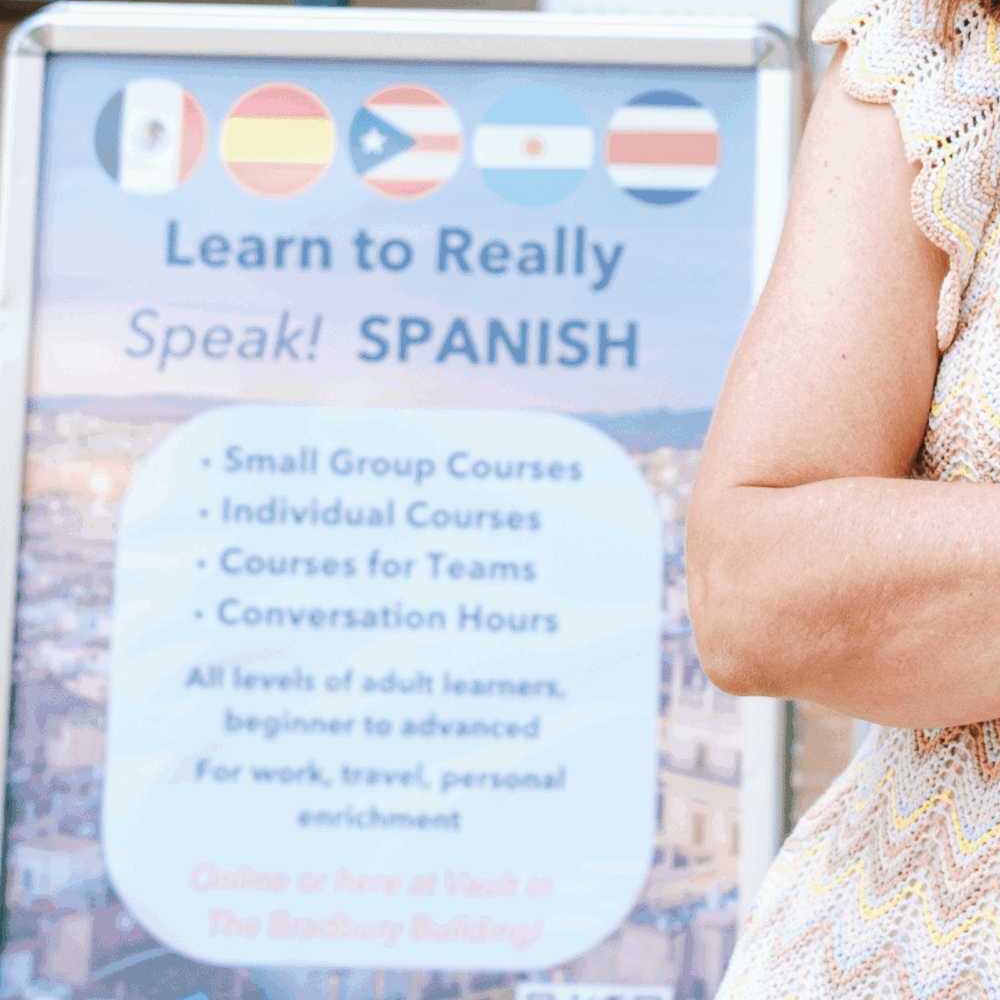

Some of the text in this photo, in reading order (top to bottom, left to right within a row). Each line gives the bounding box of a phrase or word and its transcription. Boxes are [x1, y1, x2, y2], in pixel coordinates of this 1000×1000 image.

[166, 220, 625, 292] Learn to Really
[125, 308, 638, 373] Speak! SPANISH
[224, 445, 583, 486] Small Group Courses
[222, 496, 542, 532] Individual Courses
[219, 546, 537, 583] Courses for Teams
[216, 597, 559, 634] Conversation Hours
[185, 665, 225, 688] All
[232, 665, 315, 692] levels
[324, 668, 354, 693] of
[361, 670, 434, 695] adult
[223, 707, 540, 741] beginner to advanced
[194, 757, 567, 794] For work, travel, personal
[296, 805, 462, 832] enrichment
[188, 862, 291, 894] Online
[207, 908, 262, 939] The
